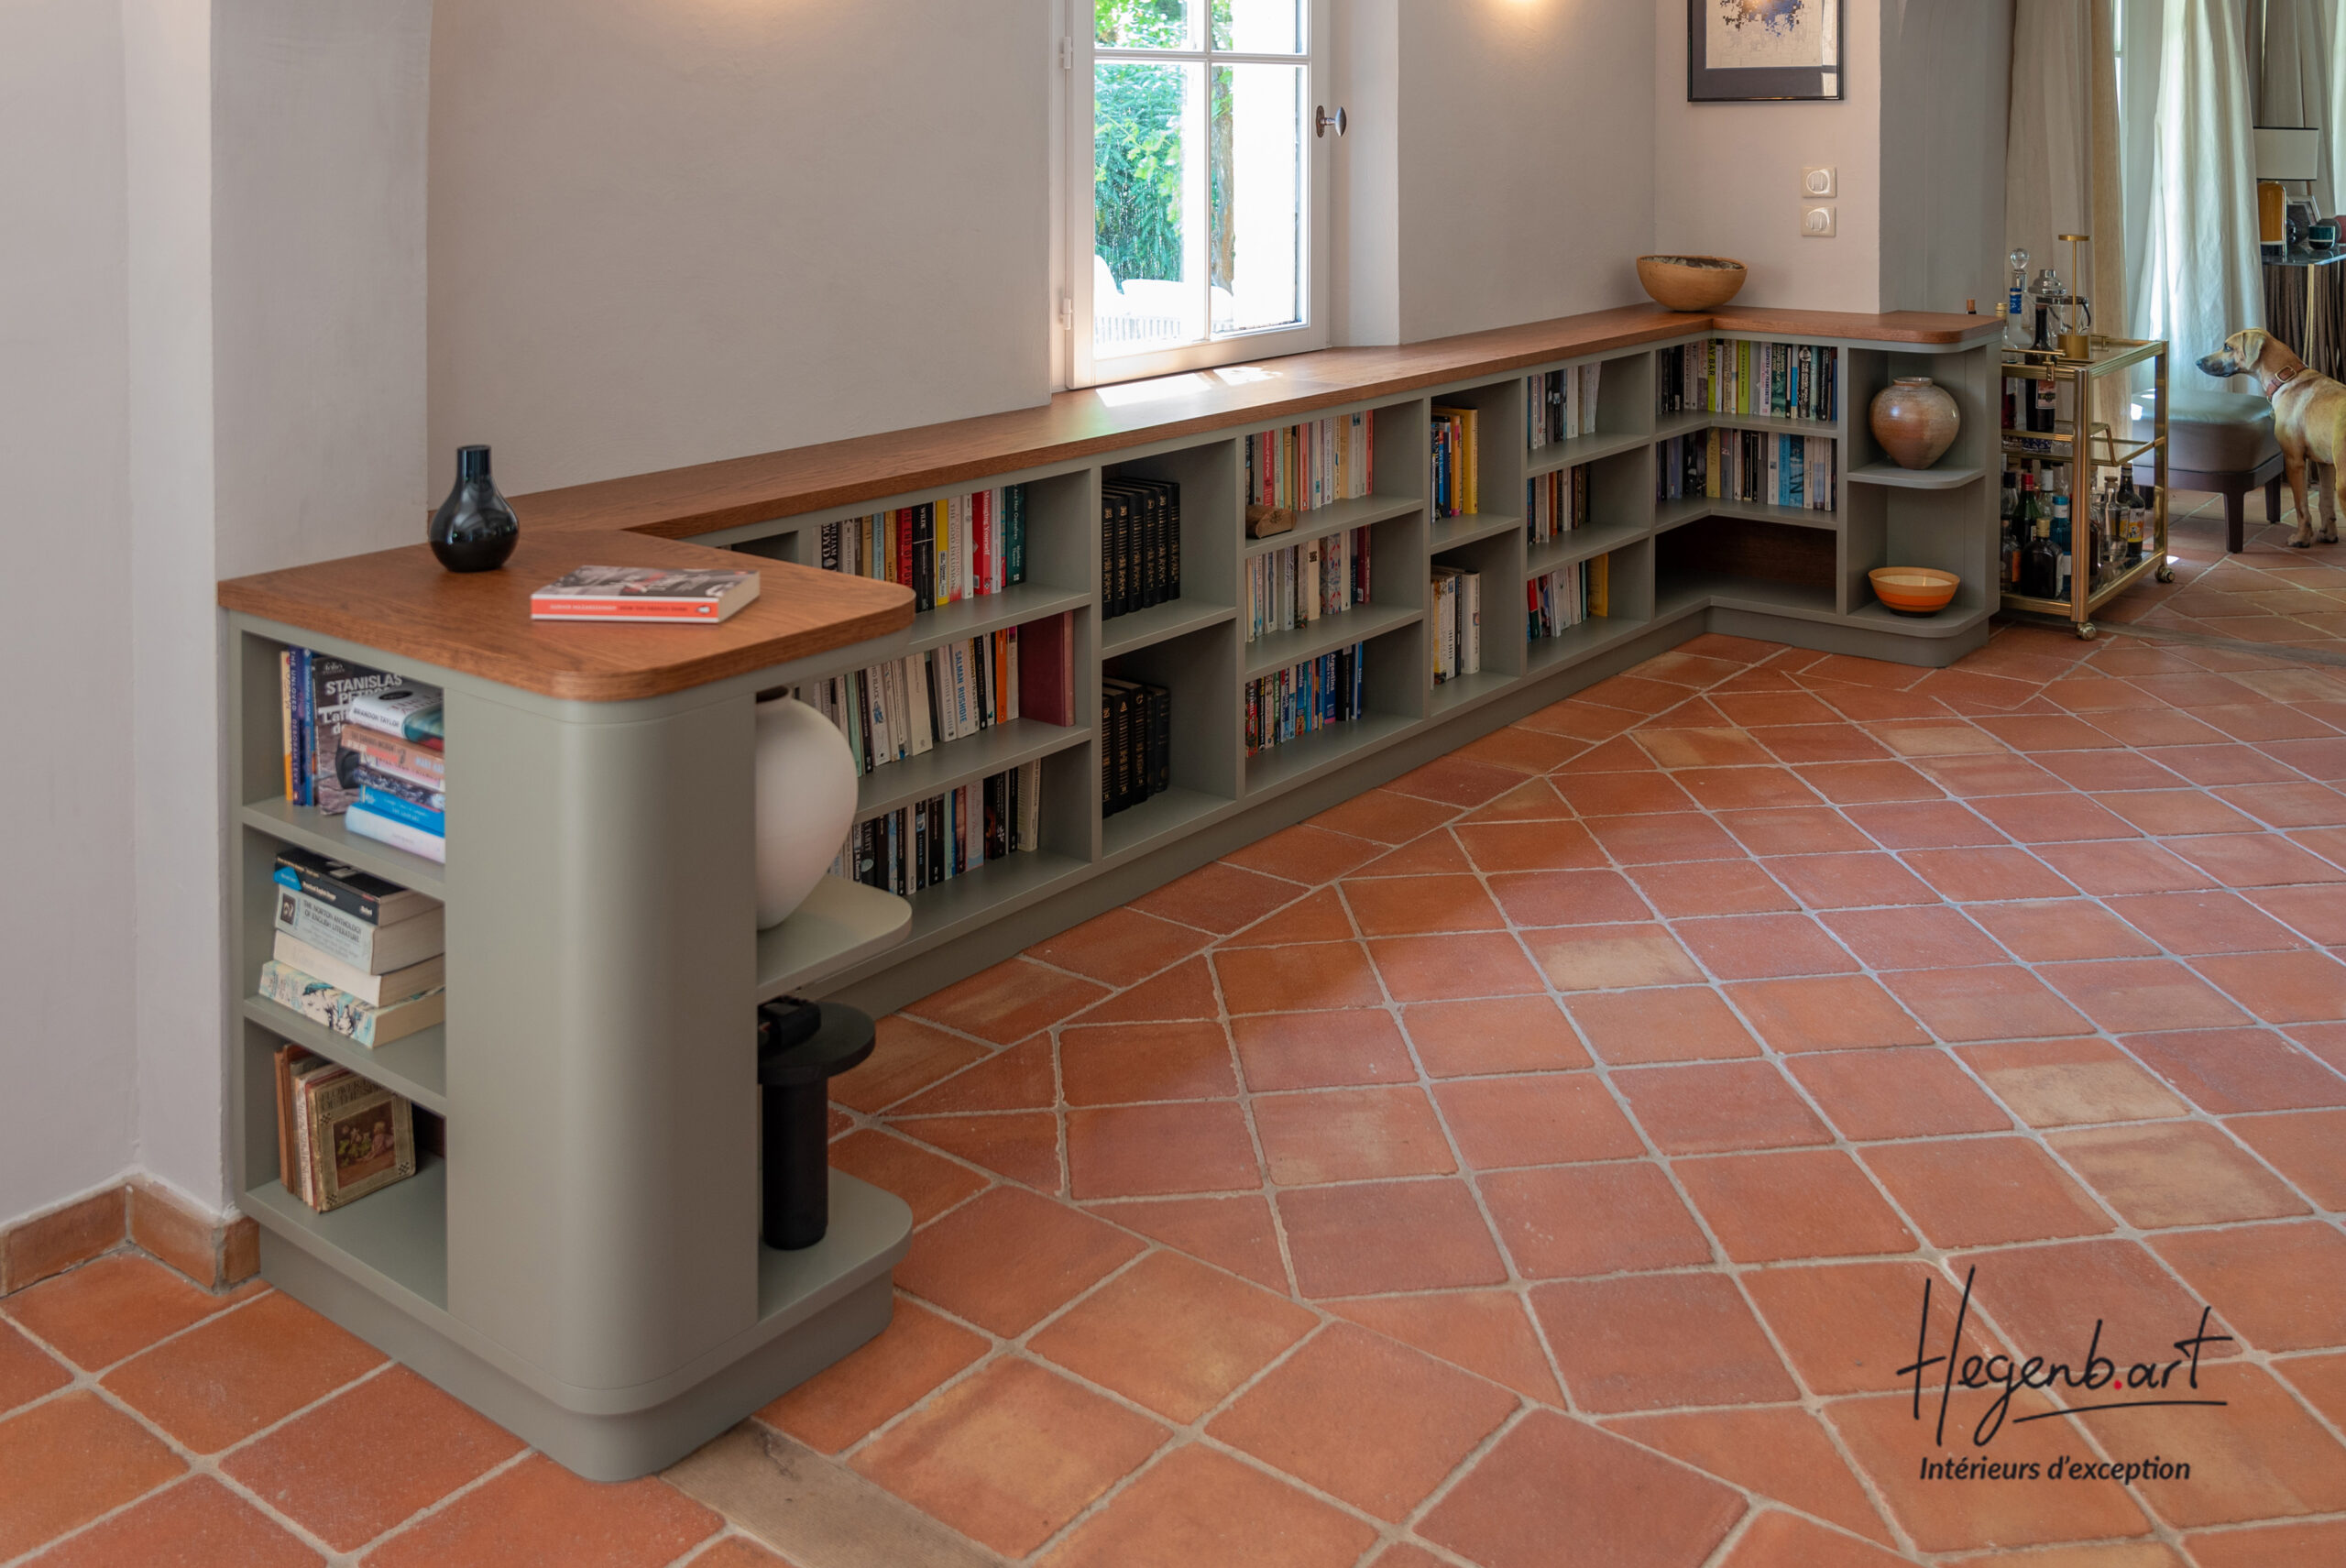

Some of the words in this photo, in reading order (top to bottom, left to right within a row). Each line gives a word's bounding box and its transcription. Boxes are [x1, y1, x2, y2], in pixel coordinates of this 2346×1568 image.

[982, 526, 992, 556] Yourself
[955, 651, 965, 685] SALMAN
[1329, 653, 1337, 691] Argentina
[324, 673, 404, 696] STANISLAS
[353, 707, 380, 721] BRANDON
[379, 715, 400, 728] TAYLOR
[957, 686, 969, 724] RUSHDIE
